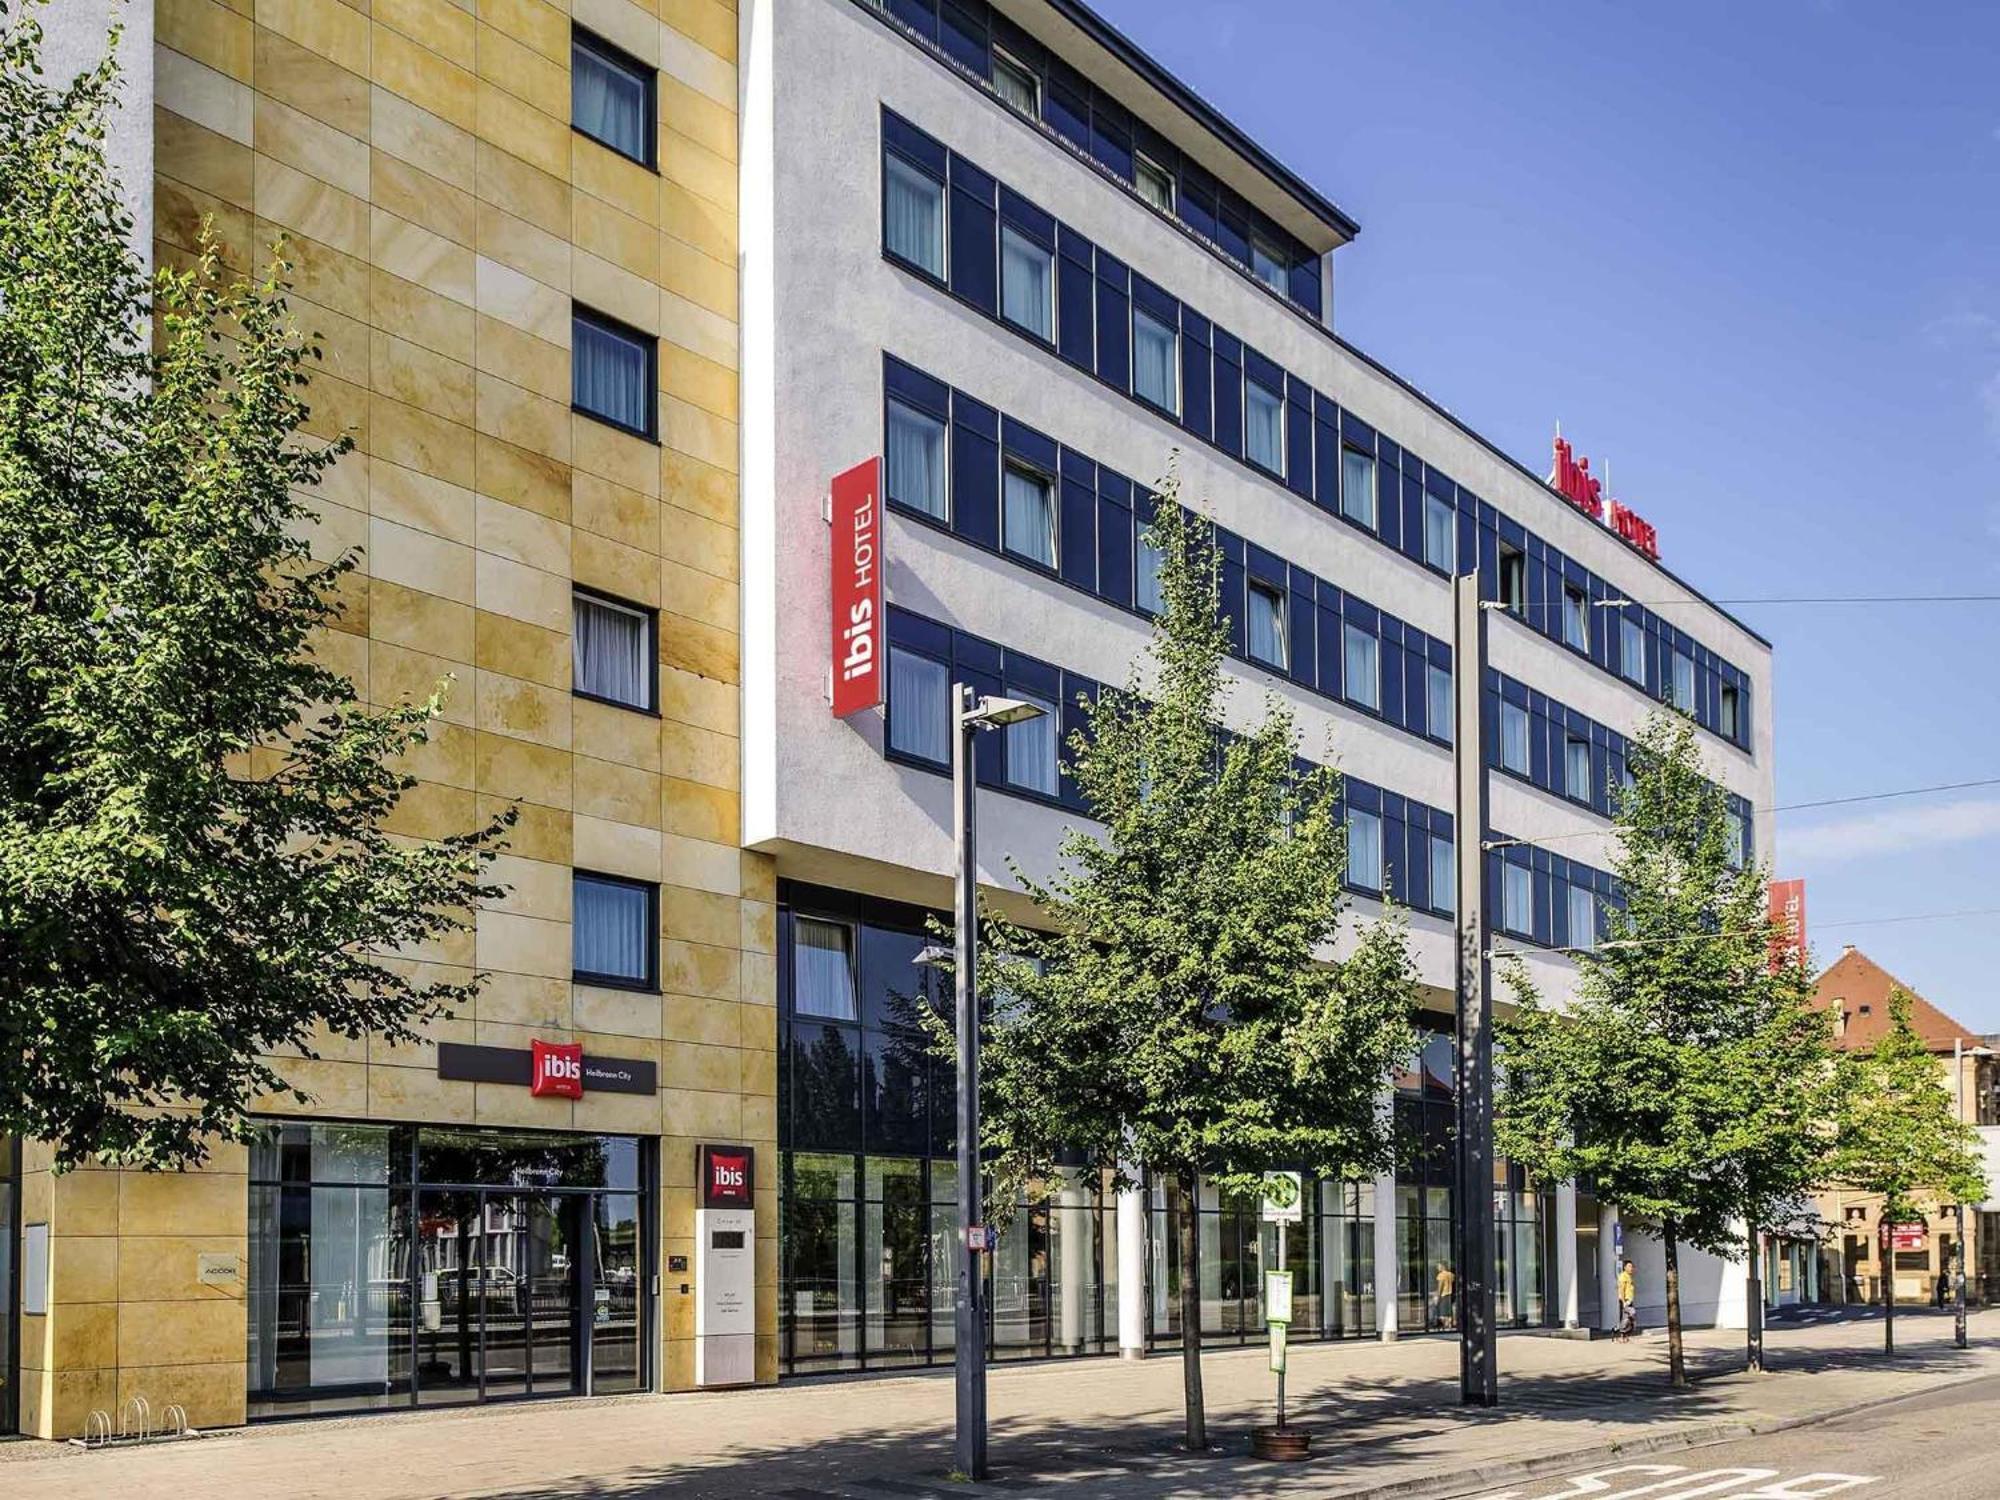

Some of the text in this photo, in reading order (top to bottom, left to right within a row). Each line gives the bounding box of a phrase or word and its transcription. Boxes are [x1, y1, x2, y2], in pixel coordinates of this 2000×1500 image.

[844, 494, 872, 681] ibis HOTEL
[544, 1054, 581, 1079] ibis
[618, 1071, 632, 1081] City
[715, 1166, 743, 1186] ibis
